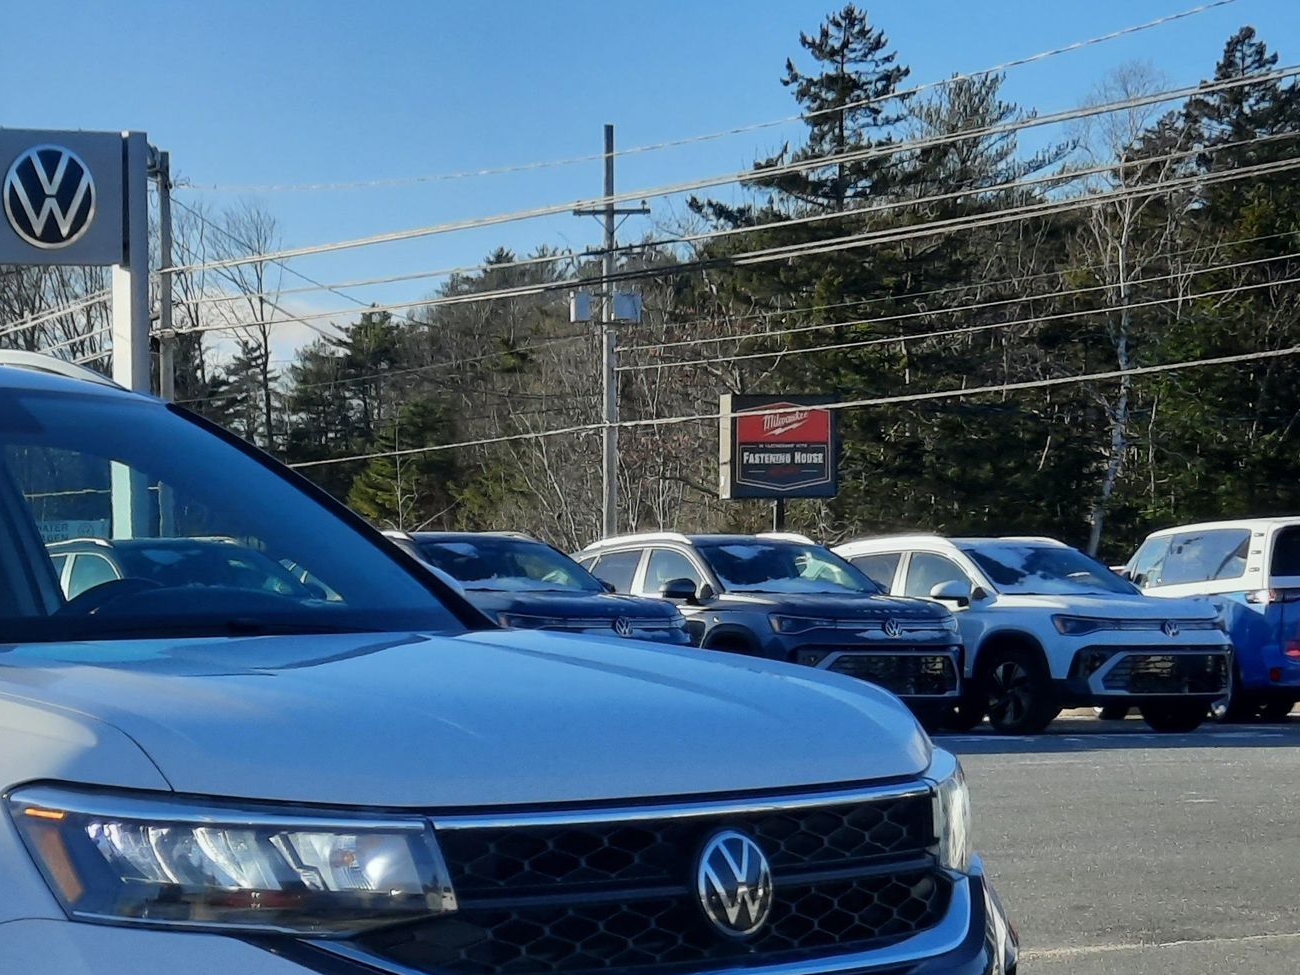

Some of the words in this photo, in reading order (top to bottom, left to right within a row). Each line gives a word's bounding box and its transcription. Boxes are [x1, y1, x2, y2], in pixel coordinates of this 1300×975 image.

[3, 144, 96, 249] VW
[762, 411, 808, 431] Milwaukee
[698, 830, 773, 936] VW
